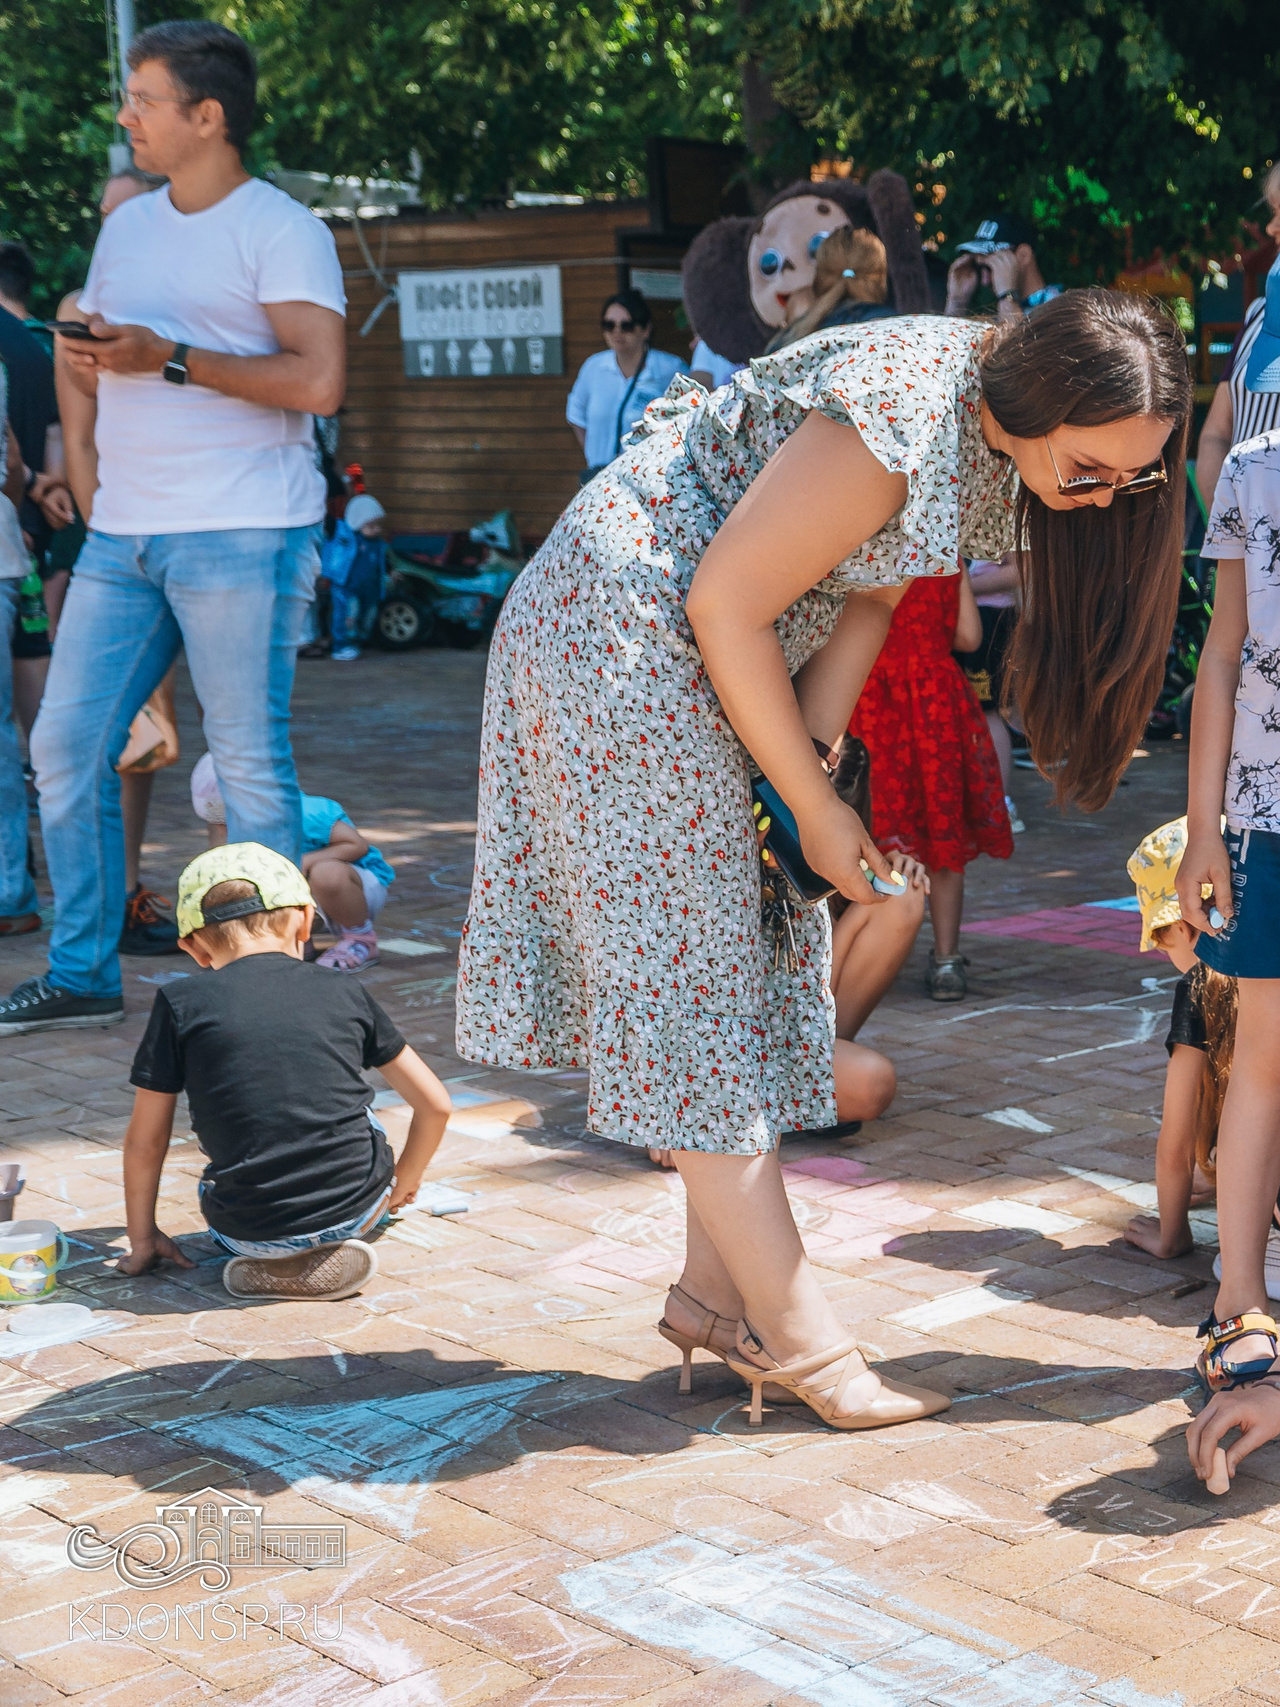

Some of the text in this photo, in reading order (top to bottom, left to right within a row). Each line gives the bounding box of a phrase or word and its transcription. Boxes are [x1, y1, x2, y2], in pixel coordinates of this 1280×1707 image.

[414, 272, 543, 312] КОФЕ С СОБОЙ
[415, 309, 546, 337] COFFEE TO GO
